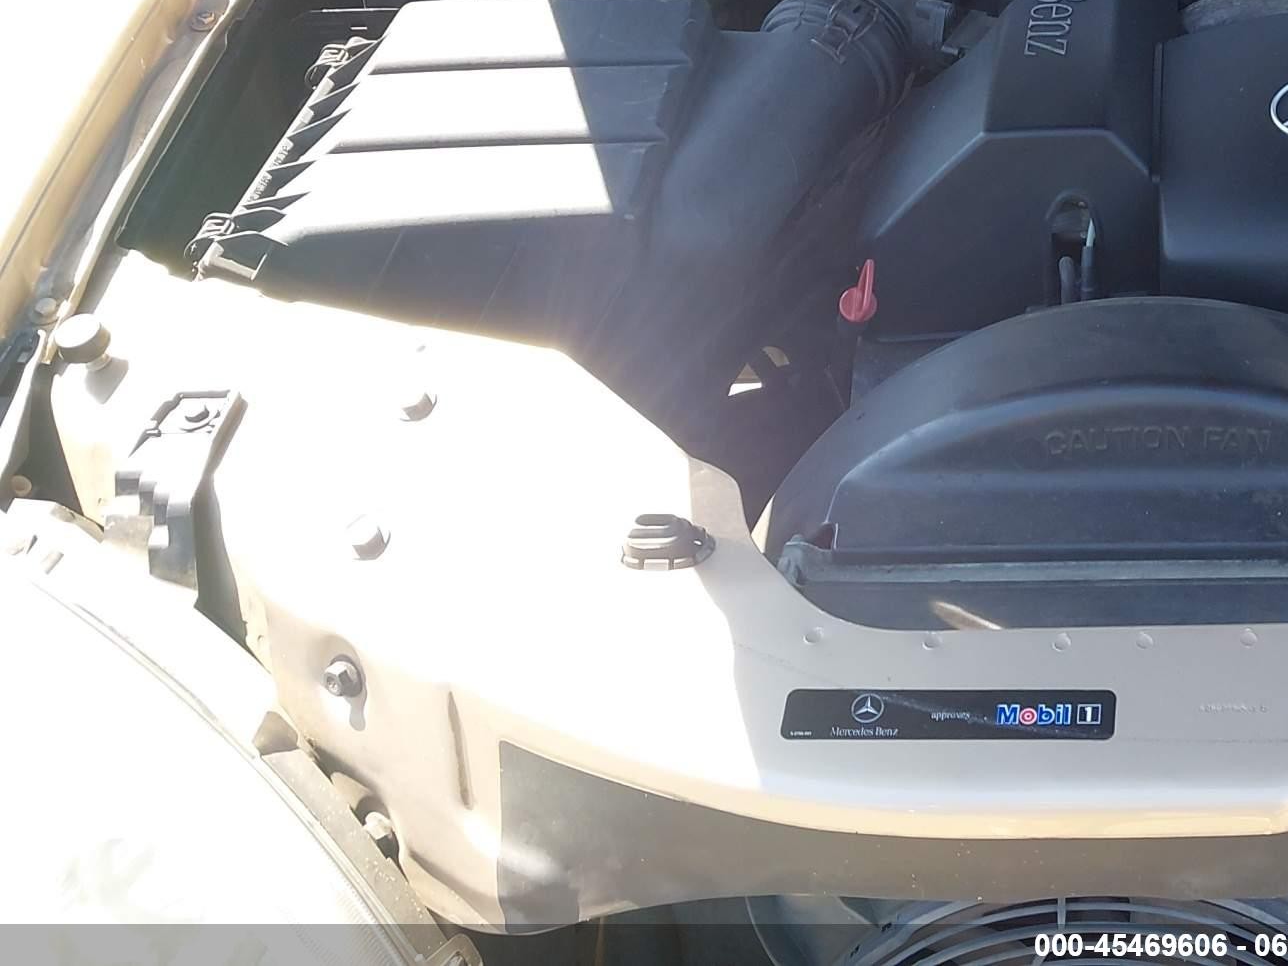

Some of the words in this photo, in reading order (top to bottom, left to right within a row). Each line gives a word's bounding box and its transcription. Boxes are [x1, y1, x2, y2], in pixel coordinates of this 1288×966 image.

[1044, 425, 1186, 455] CAUTION
[1202, 426, 1272, 453] FAN
[996, 703, 1072, 725] Mobil
